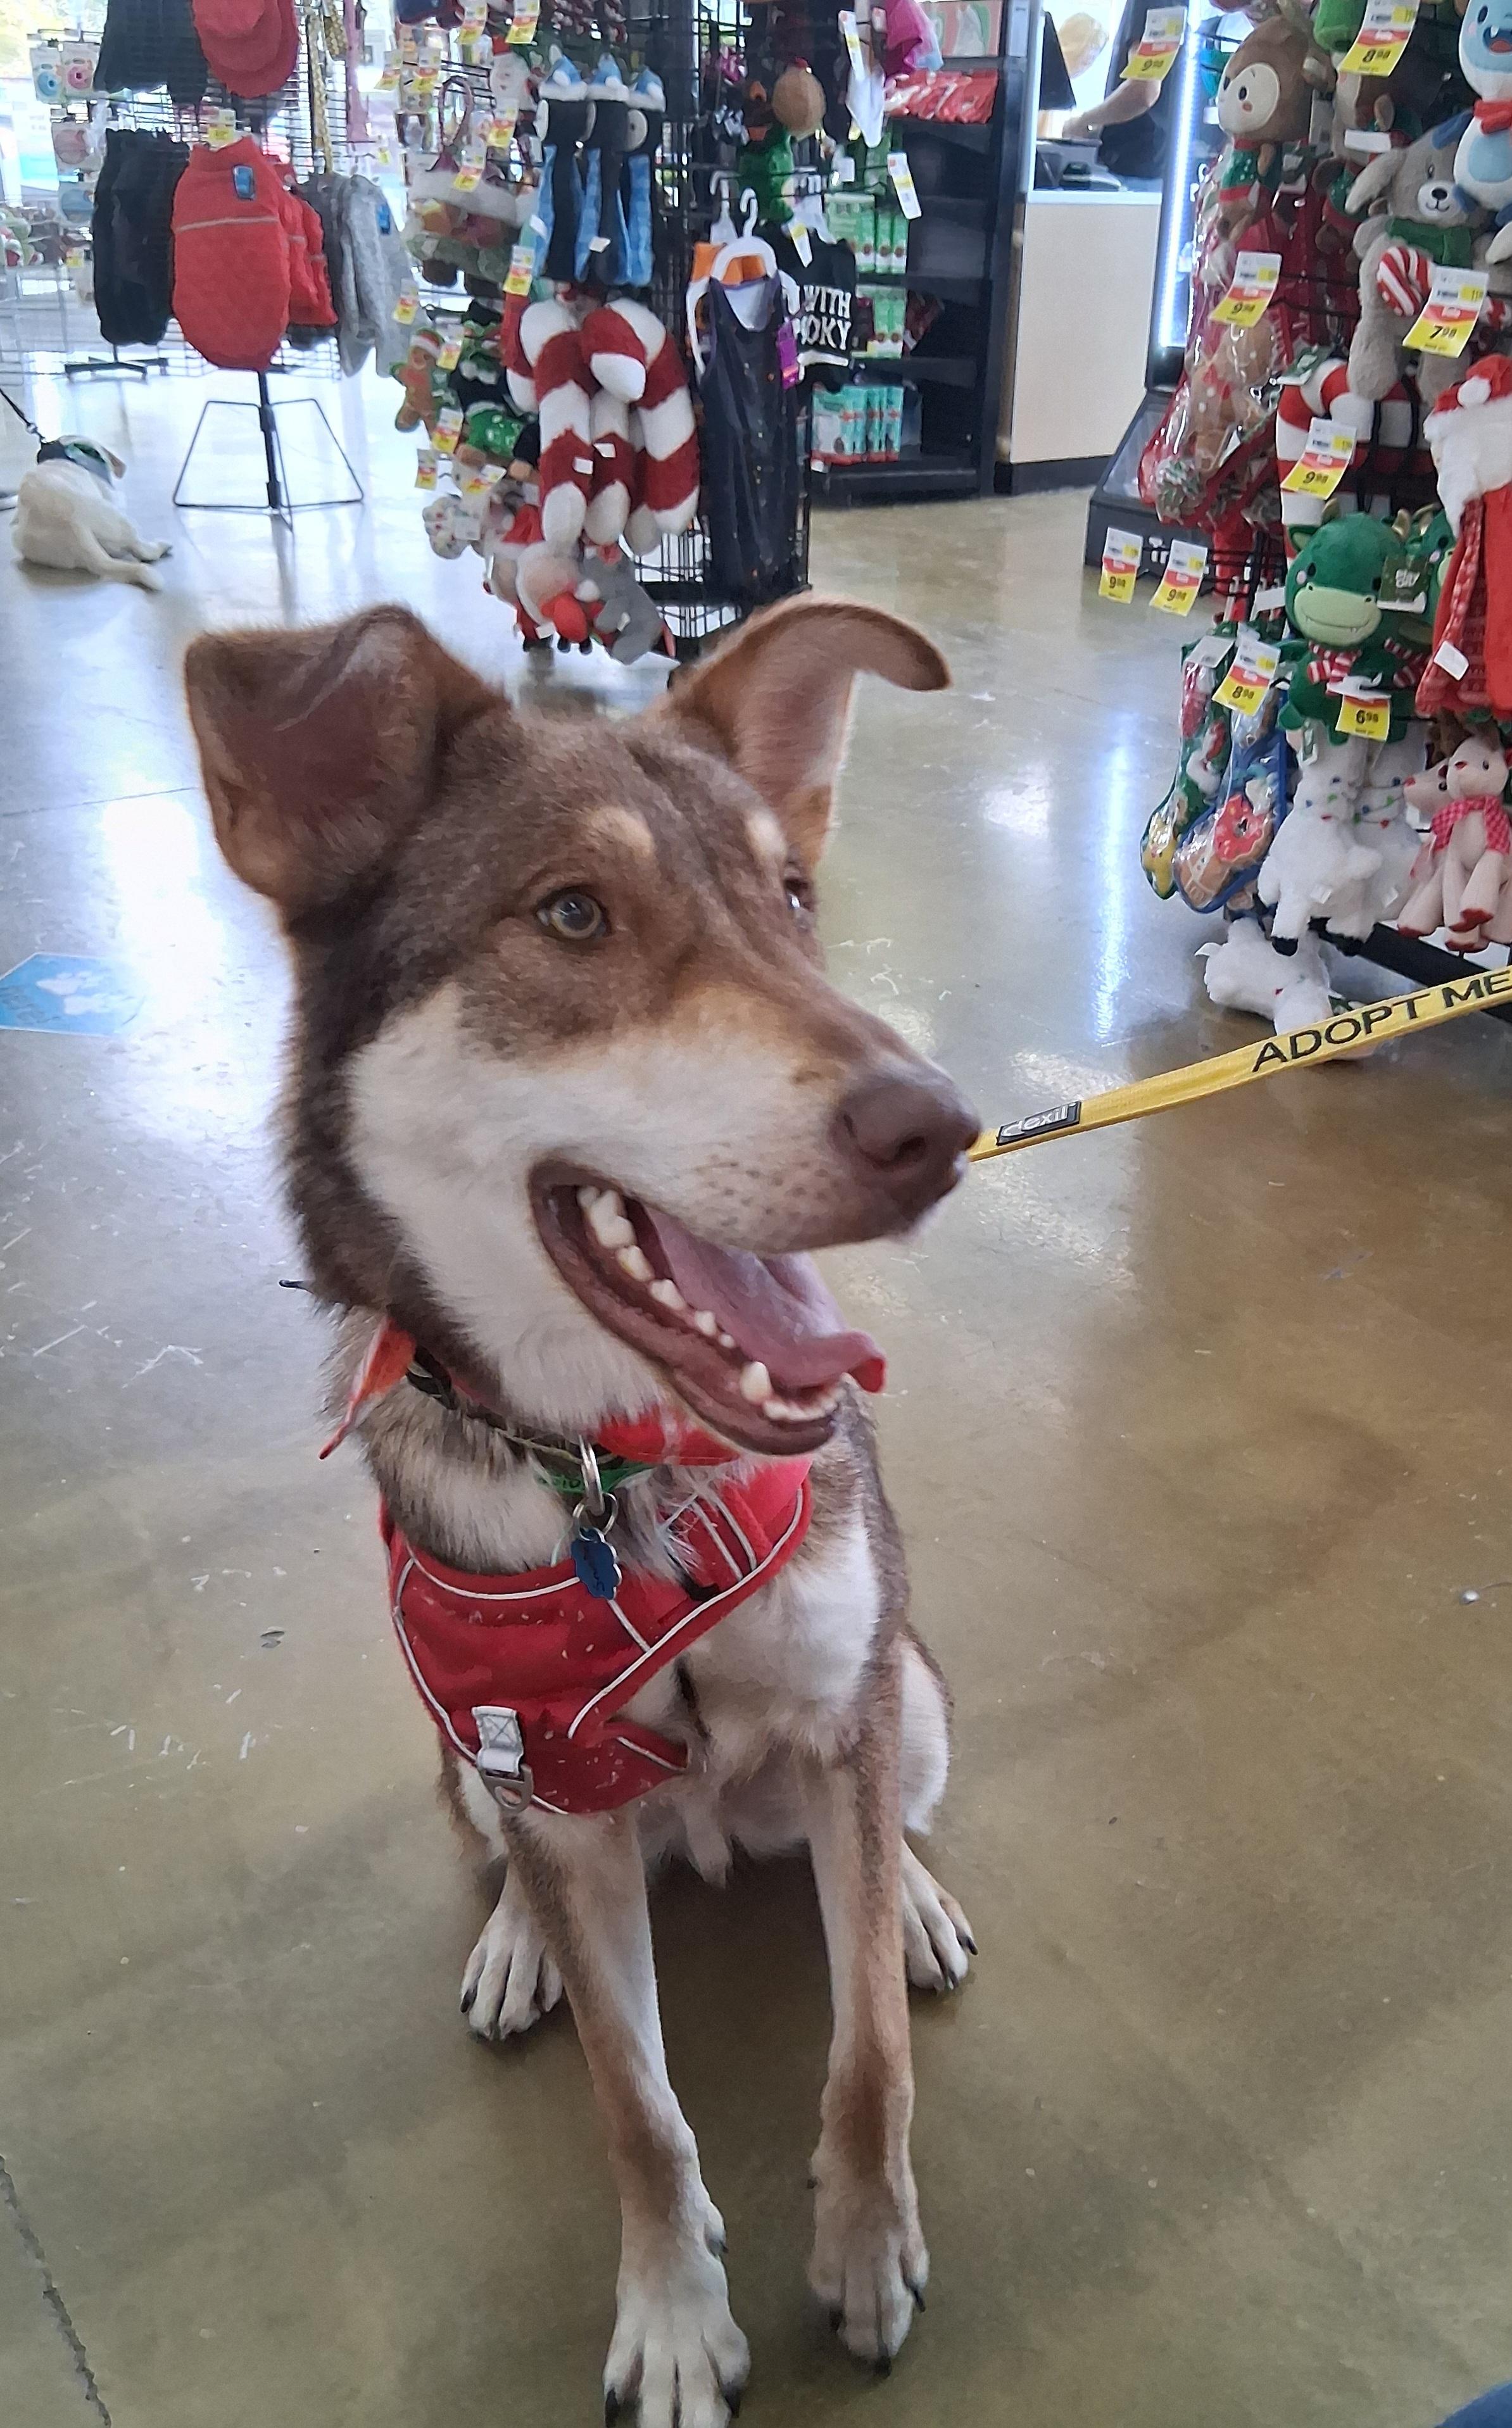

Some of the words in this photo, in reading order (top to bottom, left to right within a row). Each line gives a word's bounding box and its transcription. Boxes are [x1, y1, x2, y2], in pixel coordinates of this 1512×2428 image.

[803, 284, 852, 318] WITH
[1252, 993, 1430, 1072] ADOPT
[1441, 969, 1512, 1008] ME
